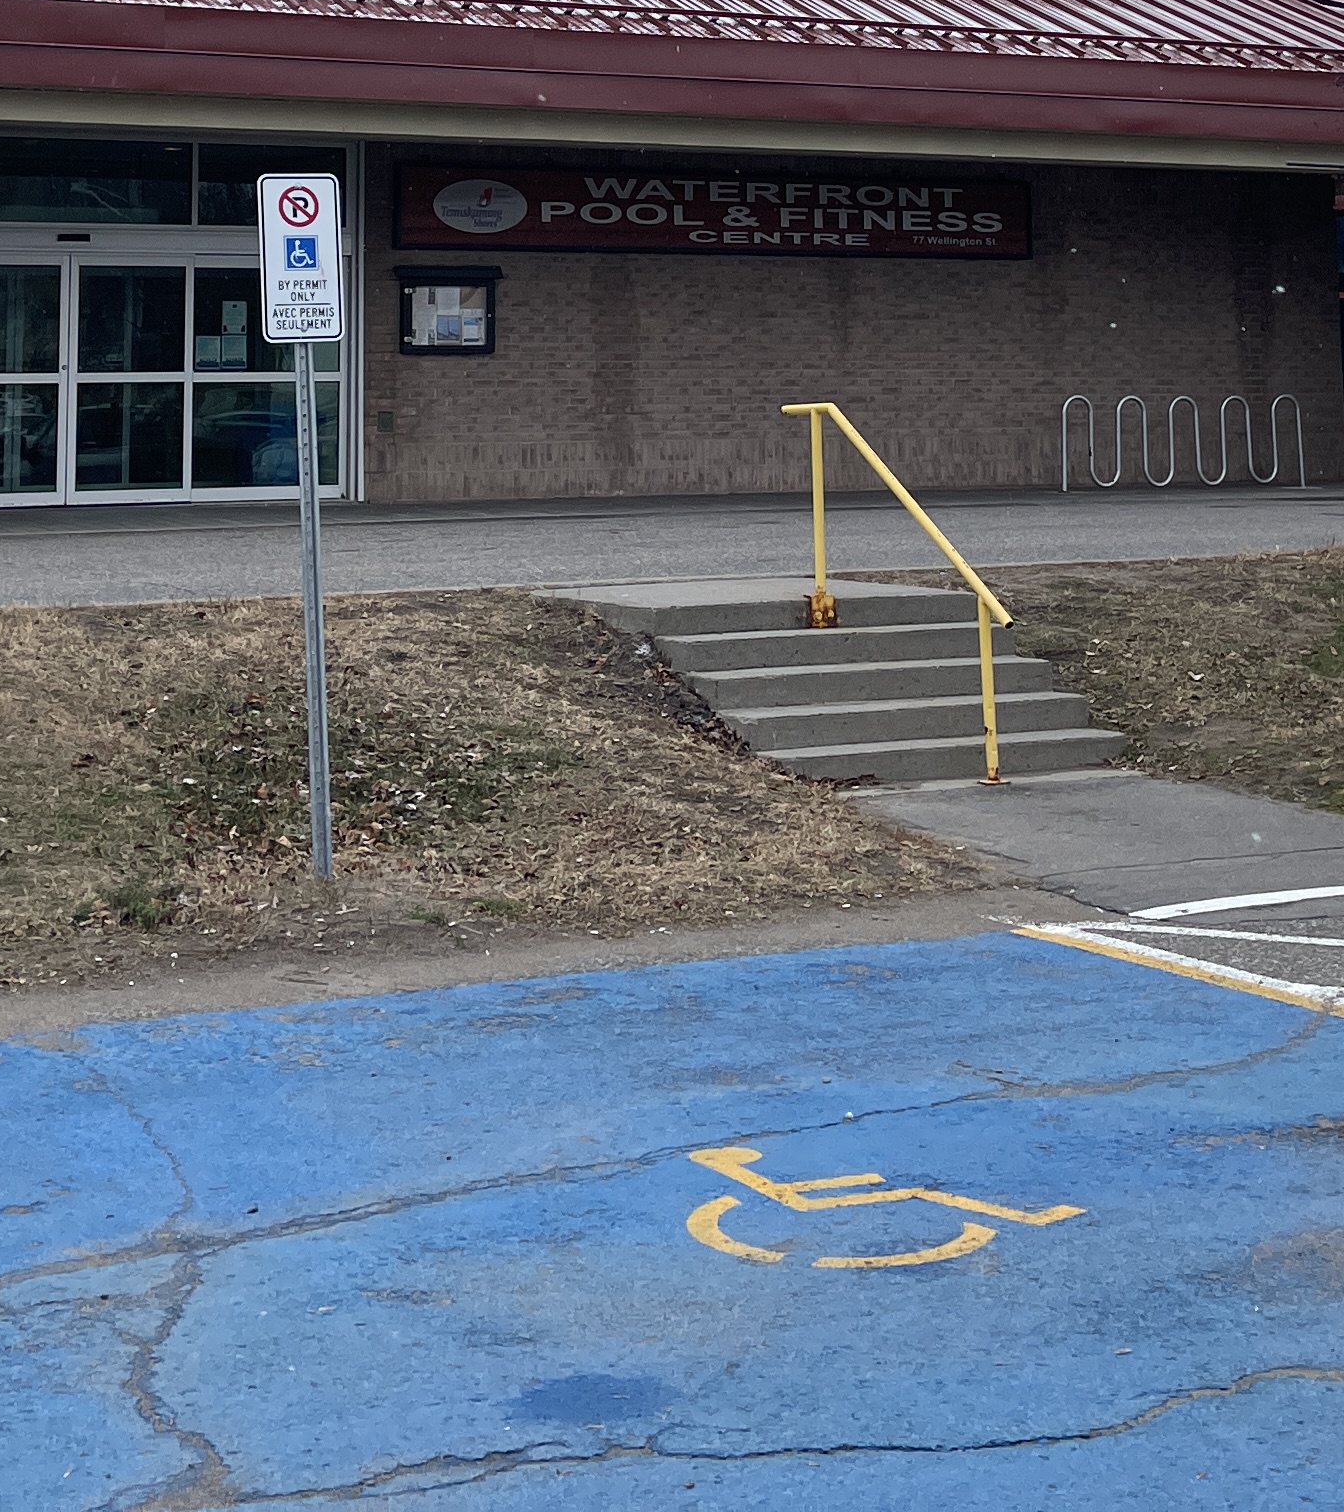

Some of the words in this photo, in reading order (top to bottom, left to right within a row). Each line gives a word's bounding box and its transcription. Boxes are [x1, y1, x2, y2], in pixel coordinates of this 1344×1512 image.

[584, 177, 963, 208] WATERFRONT
[541, 201, 705, 225] POOL
[722, 205, 760, 227] &
[780, 207, 1003, 233] FITNESS
[688, 230, 870, 246] CENTRE
[912, 235, 924, 244] 77
[927, 236, 983, 247] Wellington
[278, 280, 291, 290] BY
[293, 279, 328, 290] PERMIT
[290, 291, 316, 302] ONLY
[272, 307, 297, 317] AVEC
[299, 307, 335, 317] PERMIS
[275, 319, 331, 330] SEULEMENT
